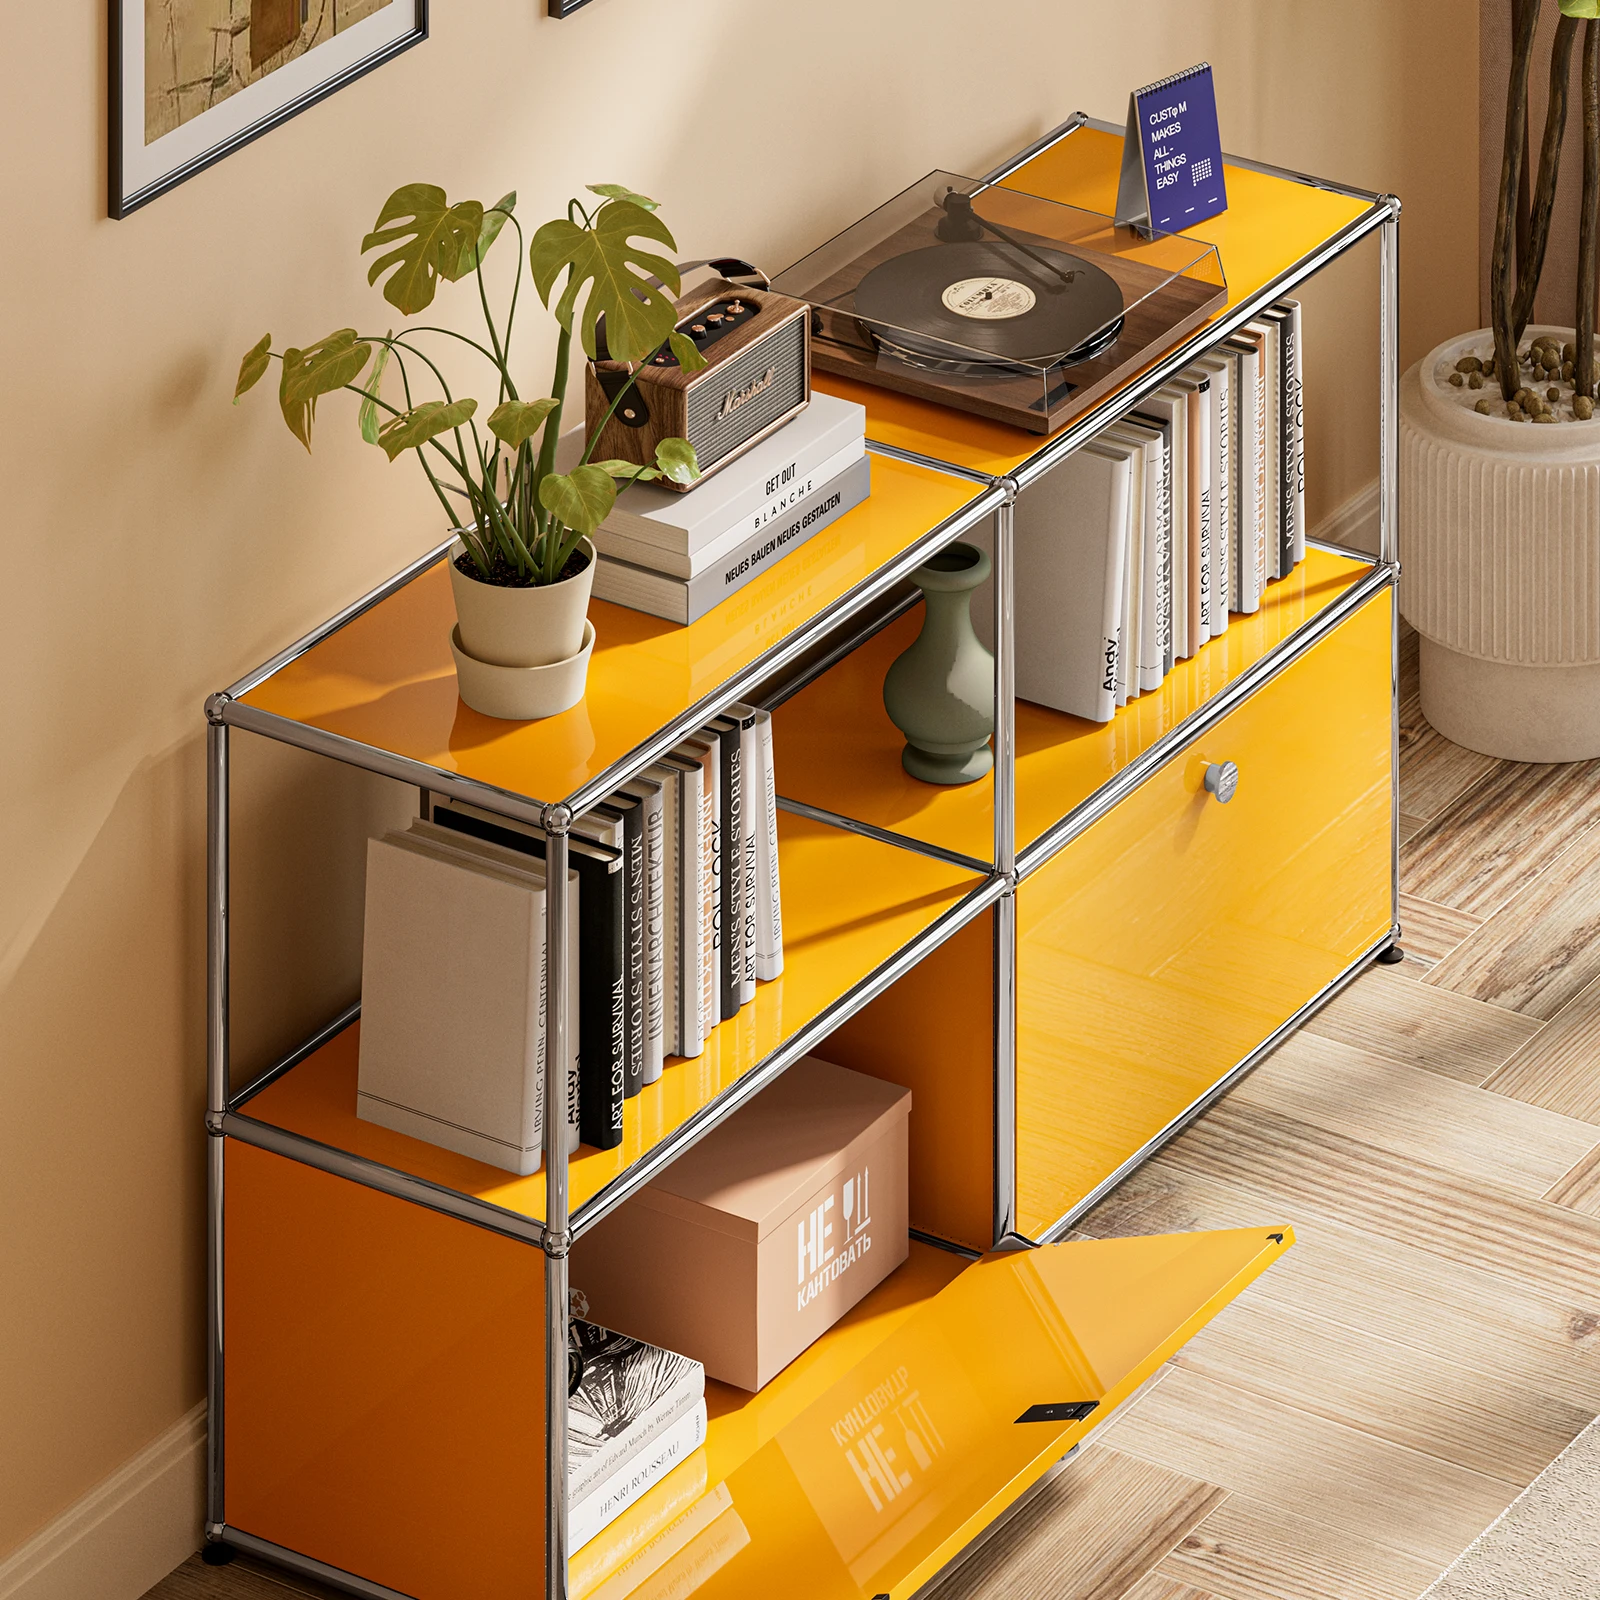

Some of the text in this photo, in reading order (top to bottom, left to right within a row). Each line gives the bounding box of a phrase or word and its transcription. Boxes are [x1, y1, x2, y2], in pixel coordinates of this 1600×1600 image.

[1151, 122, 1182, 143] MAKES
[1154, 153, 1187, 175] THINGS
[1156, 171, 1180, 190] EASY
[765, 462, 796, 496] GET OUT
[1286, 331, 1295, 550] MEN'S STYLE STORIES
[725, 558, 749, 585] NEUES
[751, 538, 776, 566] BAUEN
[776, 521, 800, 548] NEUES
[802, 491, 841, 529] GESTALTEN
[754, 480, 813, 529] BLANCHE
[1220, 481, 1229, 541] STYLE
[1200, 487, 1210, 626] ART FOR SURVIVAL
[1102, 639, 1117, 692] Andy
[730, 747, 741, 989] MEN'S STYLE STORIES
[744, 830, 756, 982] ART FOR SURVIVAL
[631, 834, 643, 1078] MEN'S STYLE STORIES
[648, 807, 663, 1041] INNENARCHITEKTUR
[611, 973, 623, 1130] ART FOR SURVIVAL
[534, 1078, 544, 1134] IRVING
[797, 1194, 834, 1285] НЕ
[797, 1232, 872, 1312] КАНТОВАТЬ
[599, 1440, 681, 1518] HENRI ROUSSEAU
